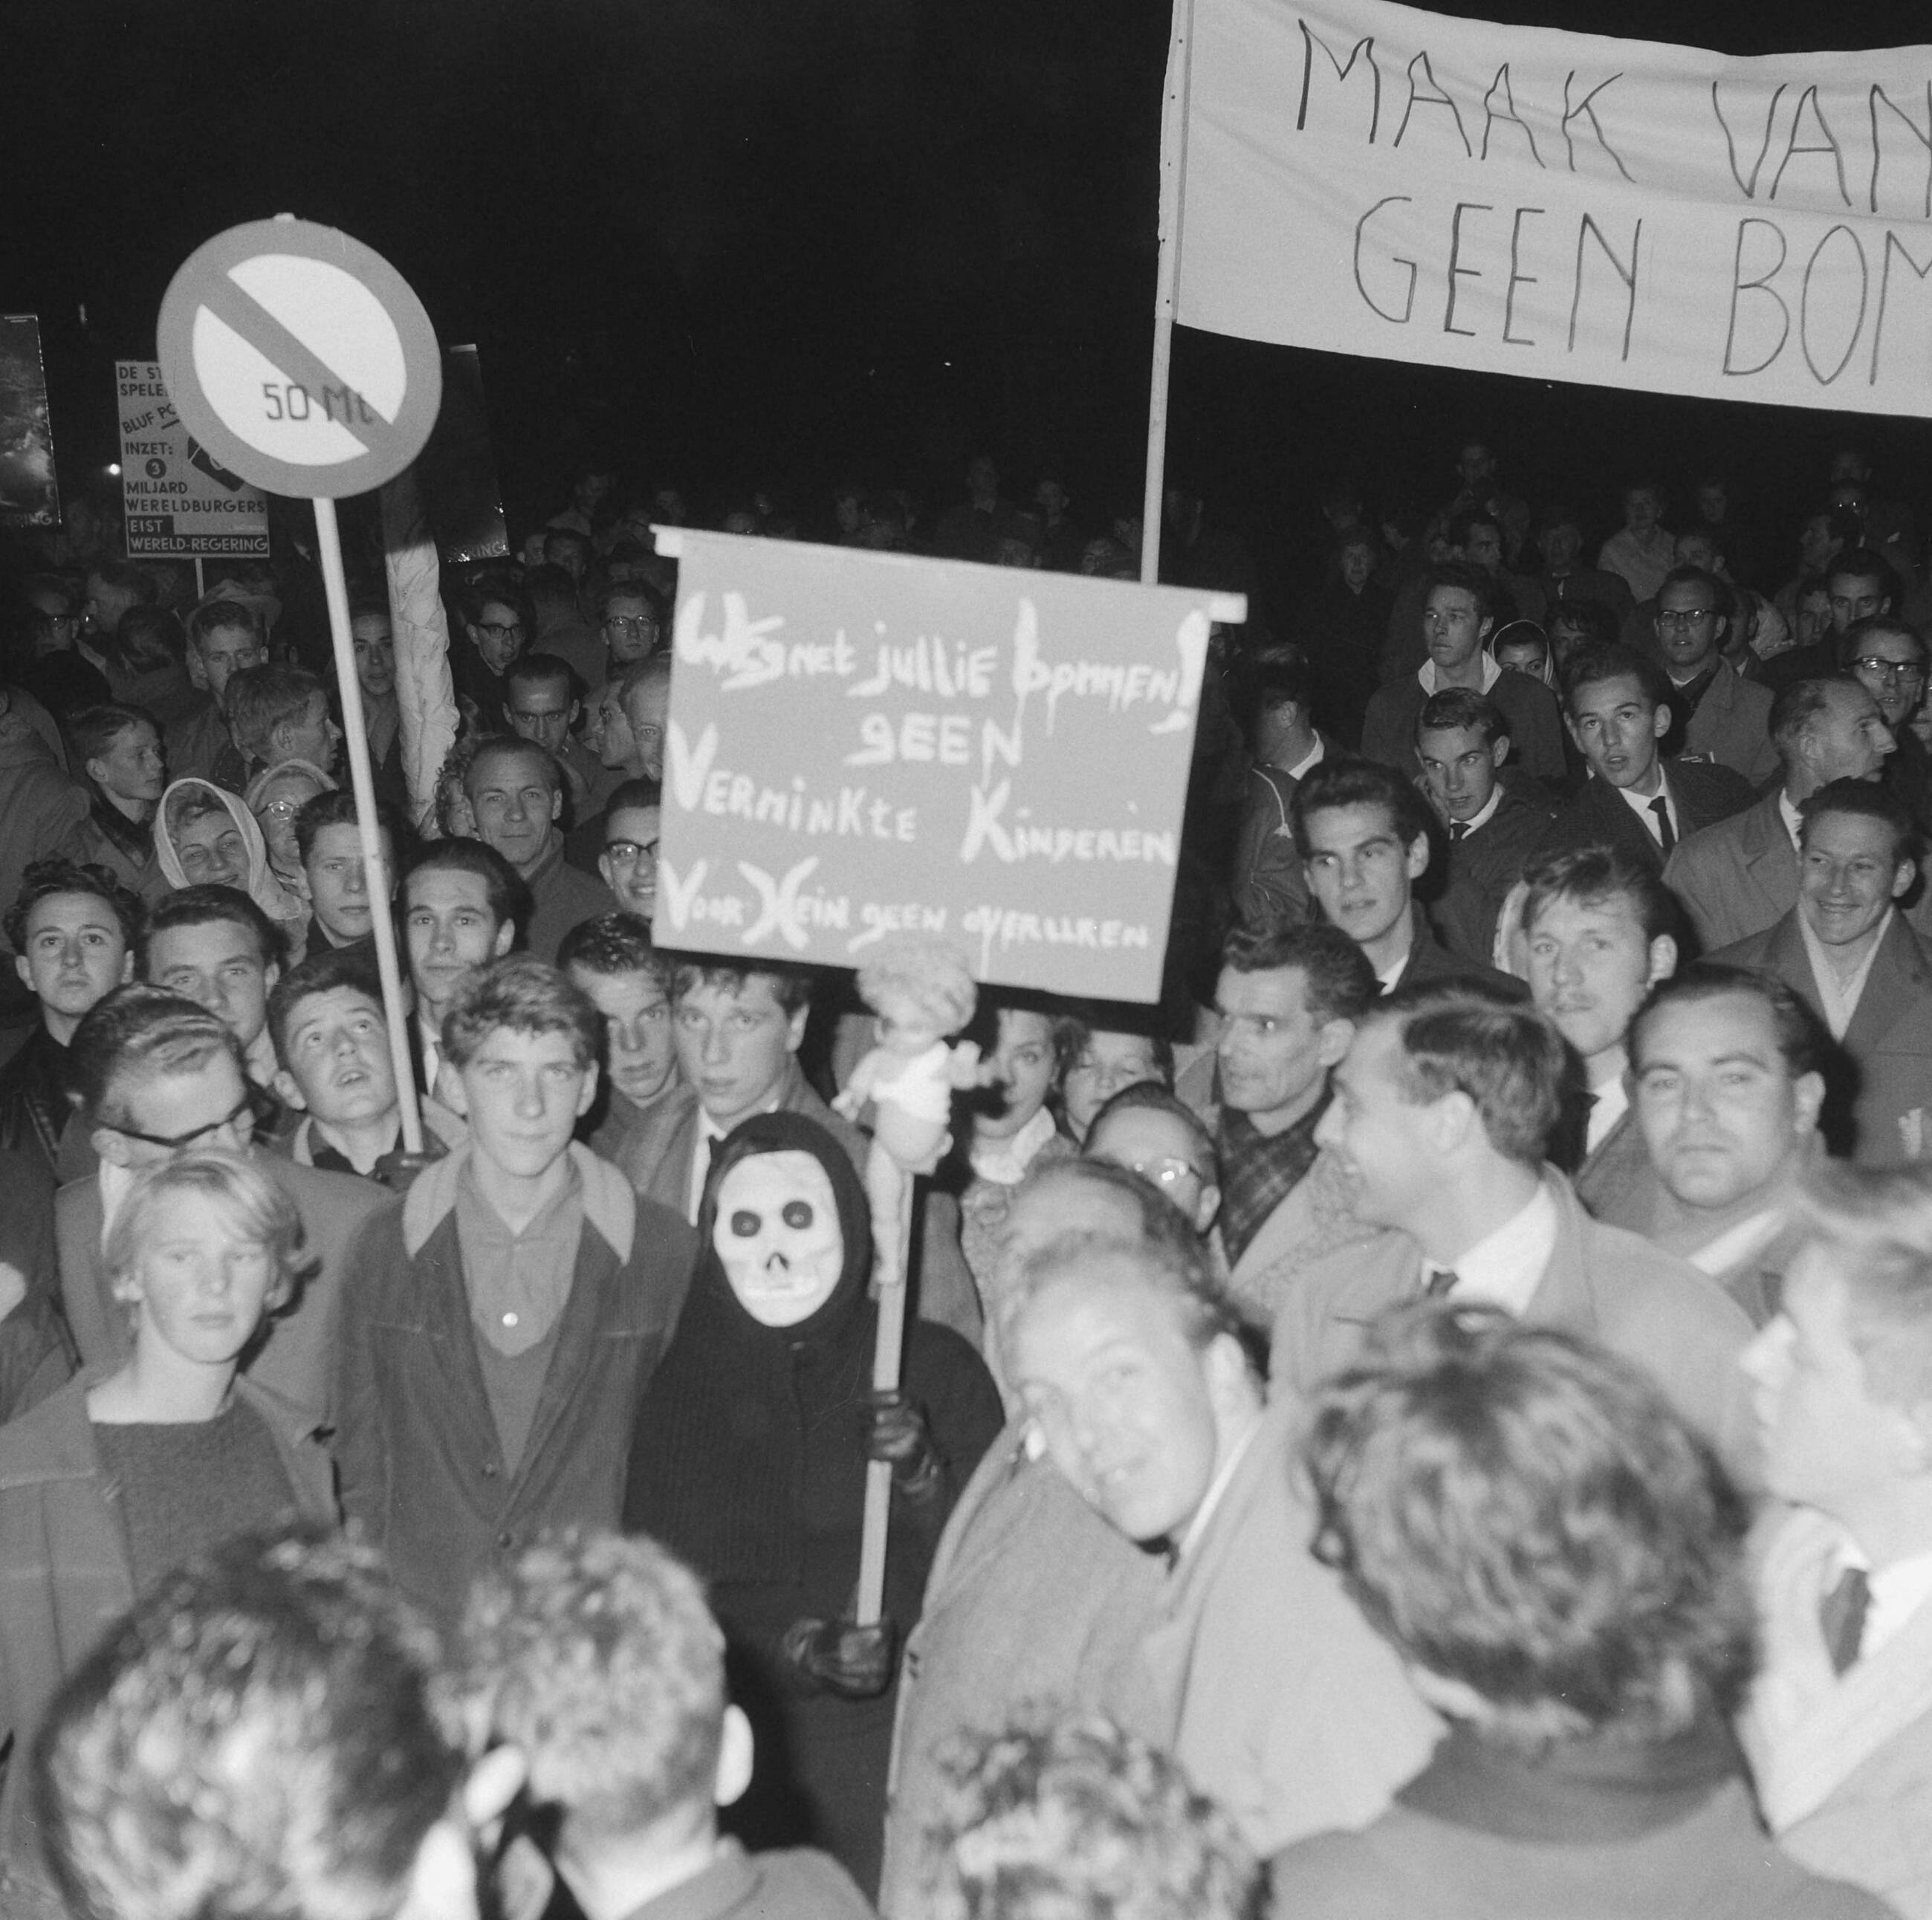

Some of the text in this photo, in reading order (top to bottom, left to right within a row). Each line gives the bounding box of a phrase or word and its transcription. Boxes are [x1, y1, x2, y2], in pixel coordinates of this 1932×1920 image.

[1296, 18, 1932, 218] MAAK VAN
[1354, 195, 1643, 362] GEEN
[119, 366, 137, 380] DE
[120, 383, 169, 397] SPELE
[262, 383, 310, 421] 50
[121, 411, 155, 435] BLUF
[125, 442, 174, 455] INZET:
[150, 461, 163, 476] 3
[126, 481, 189, 495] MILJARD
[126, 499, 266, 513] WERELDBURGERS
[130, 519, 164, 533] EIST
[130, 536, 268, 551] WERELD-REGERING
